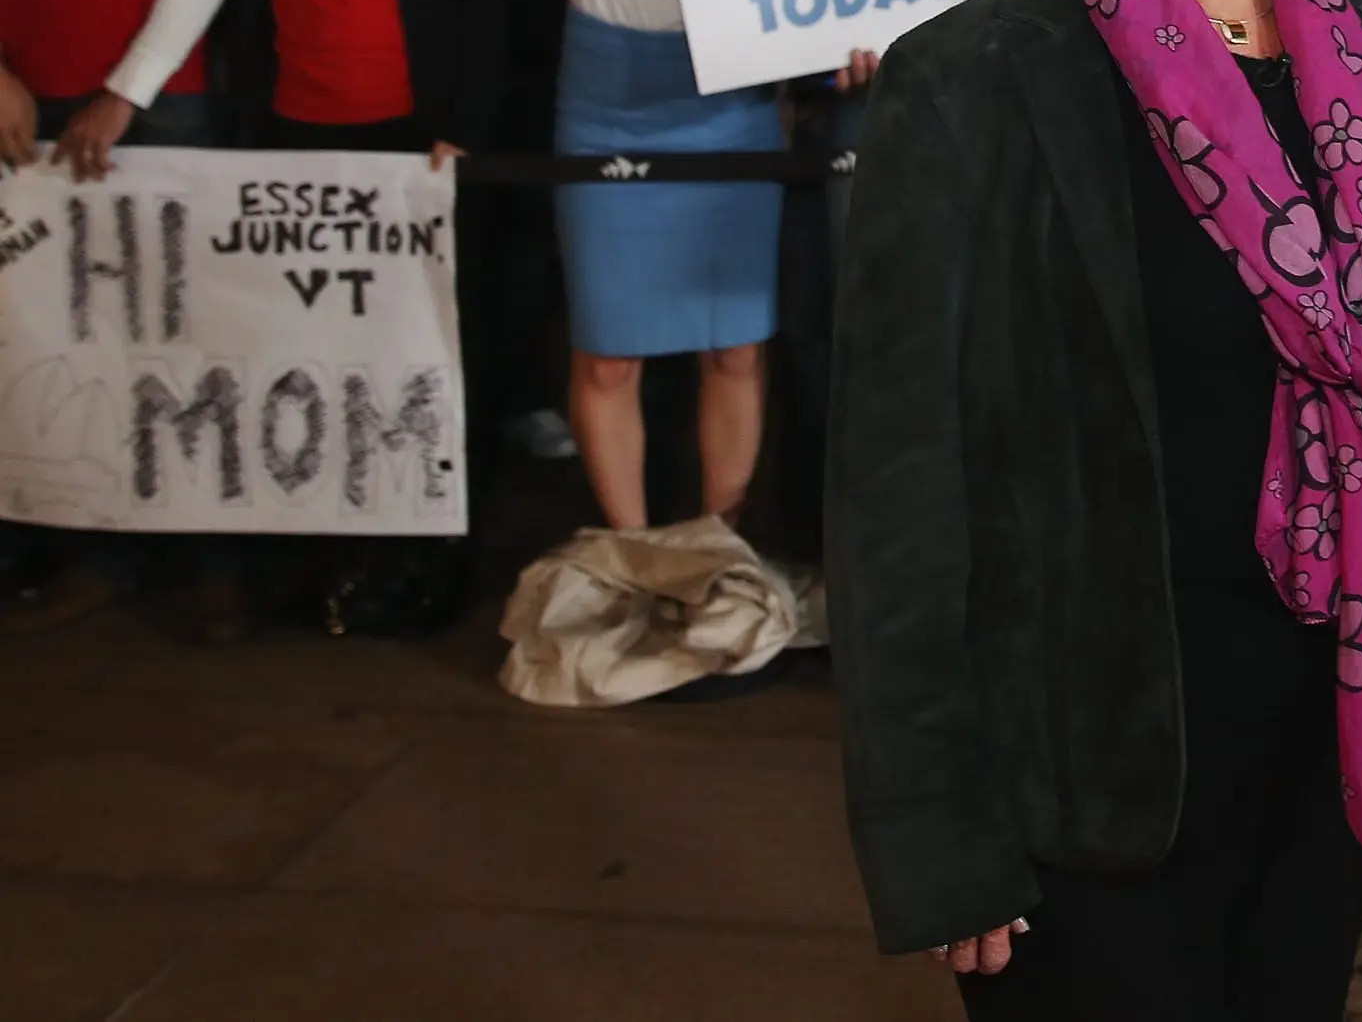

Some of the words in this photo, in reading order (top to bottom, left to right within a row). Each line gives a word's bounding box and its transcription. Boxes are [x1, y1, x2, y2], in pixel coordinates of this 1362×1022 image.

[240, 181, 381, 218] ESSEX
[67, 193, 190, 344] HI
[285, 269, 376, 316] VT
[130, 365, 452, 510] MOM
